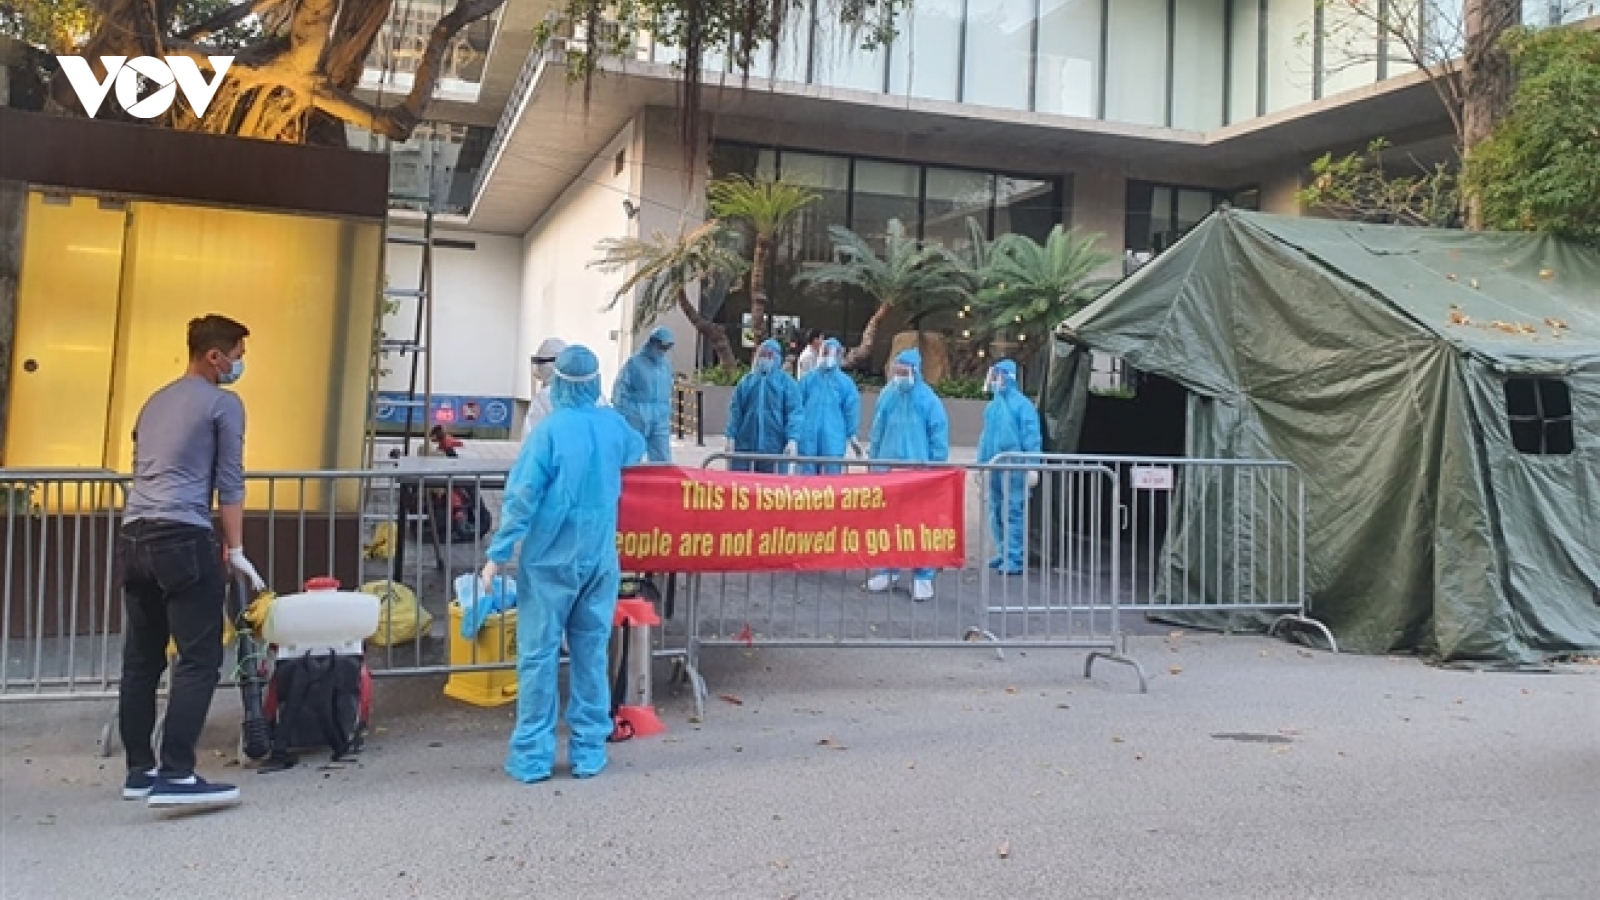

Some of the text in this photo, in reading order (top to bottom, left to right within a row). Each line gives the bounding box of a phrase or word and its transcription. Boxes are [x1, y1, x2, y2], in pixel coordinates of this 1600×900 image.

[681, 480, 887, 511] This is isolated area.
[616, 523, 956, 559] eople are not allowed to go in here
